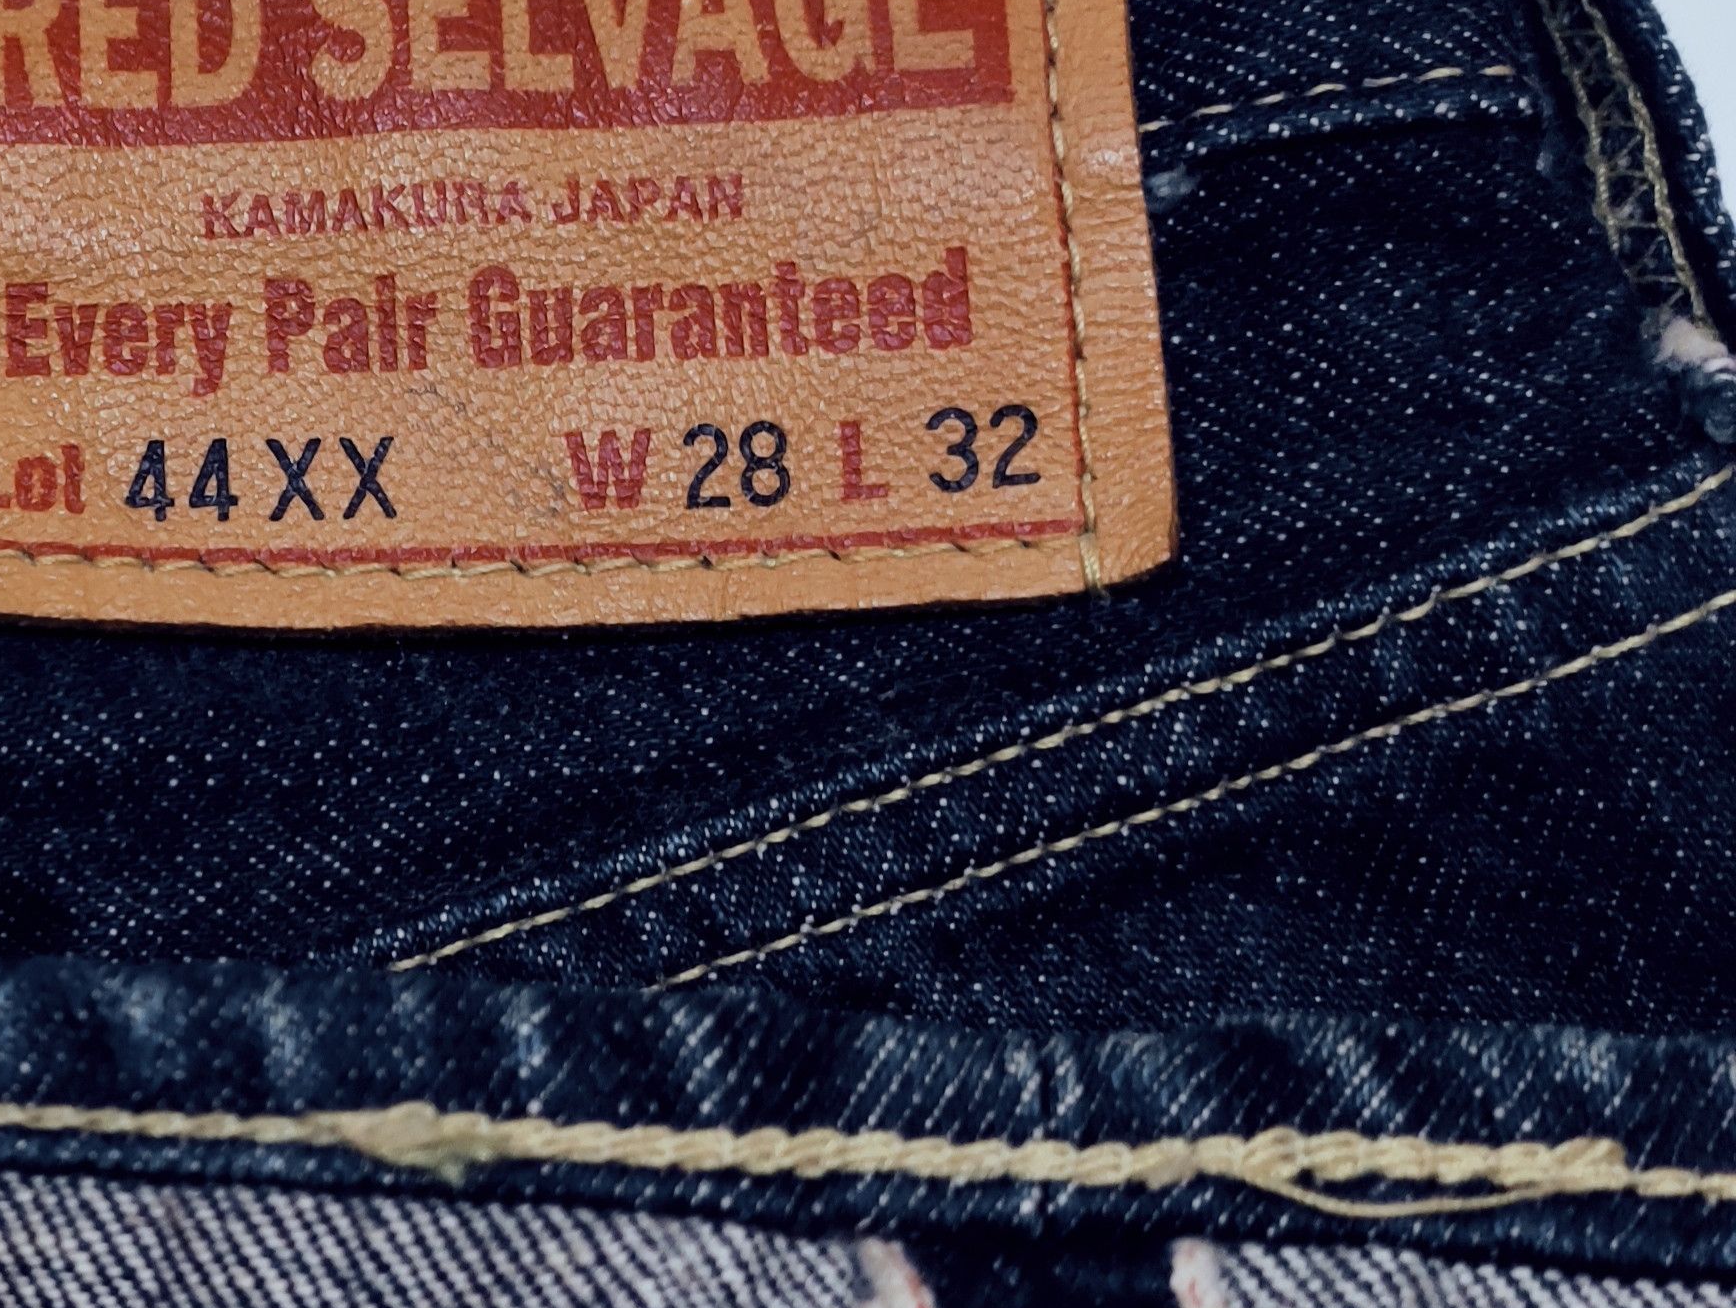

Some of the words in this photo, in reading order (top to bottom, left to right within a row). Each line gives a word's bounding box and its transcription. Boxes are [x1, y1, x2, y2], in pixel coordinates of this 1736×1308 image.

[200, 180, 534, 241] KAMAKURA
[550, 173, 745, 227] JAPAN
[4, 280, 234, 395] Every
[265, 271, 439, 375] Pair
[469, 245, 974, 369] Guaranteed
[563, 426, 652, 511] W
[681, 419, 792, 511] 28
[838, 419, 890, 503] L
[926, 403, 1042, 493] 32
